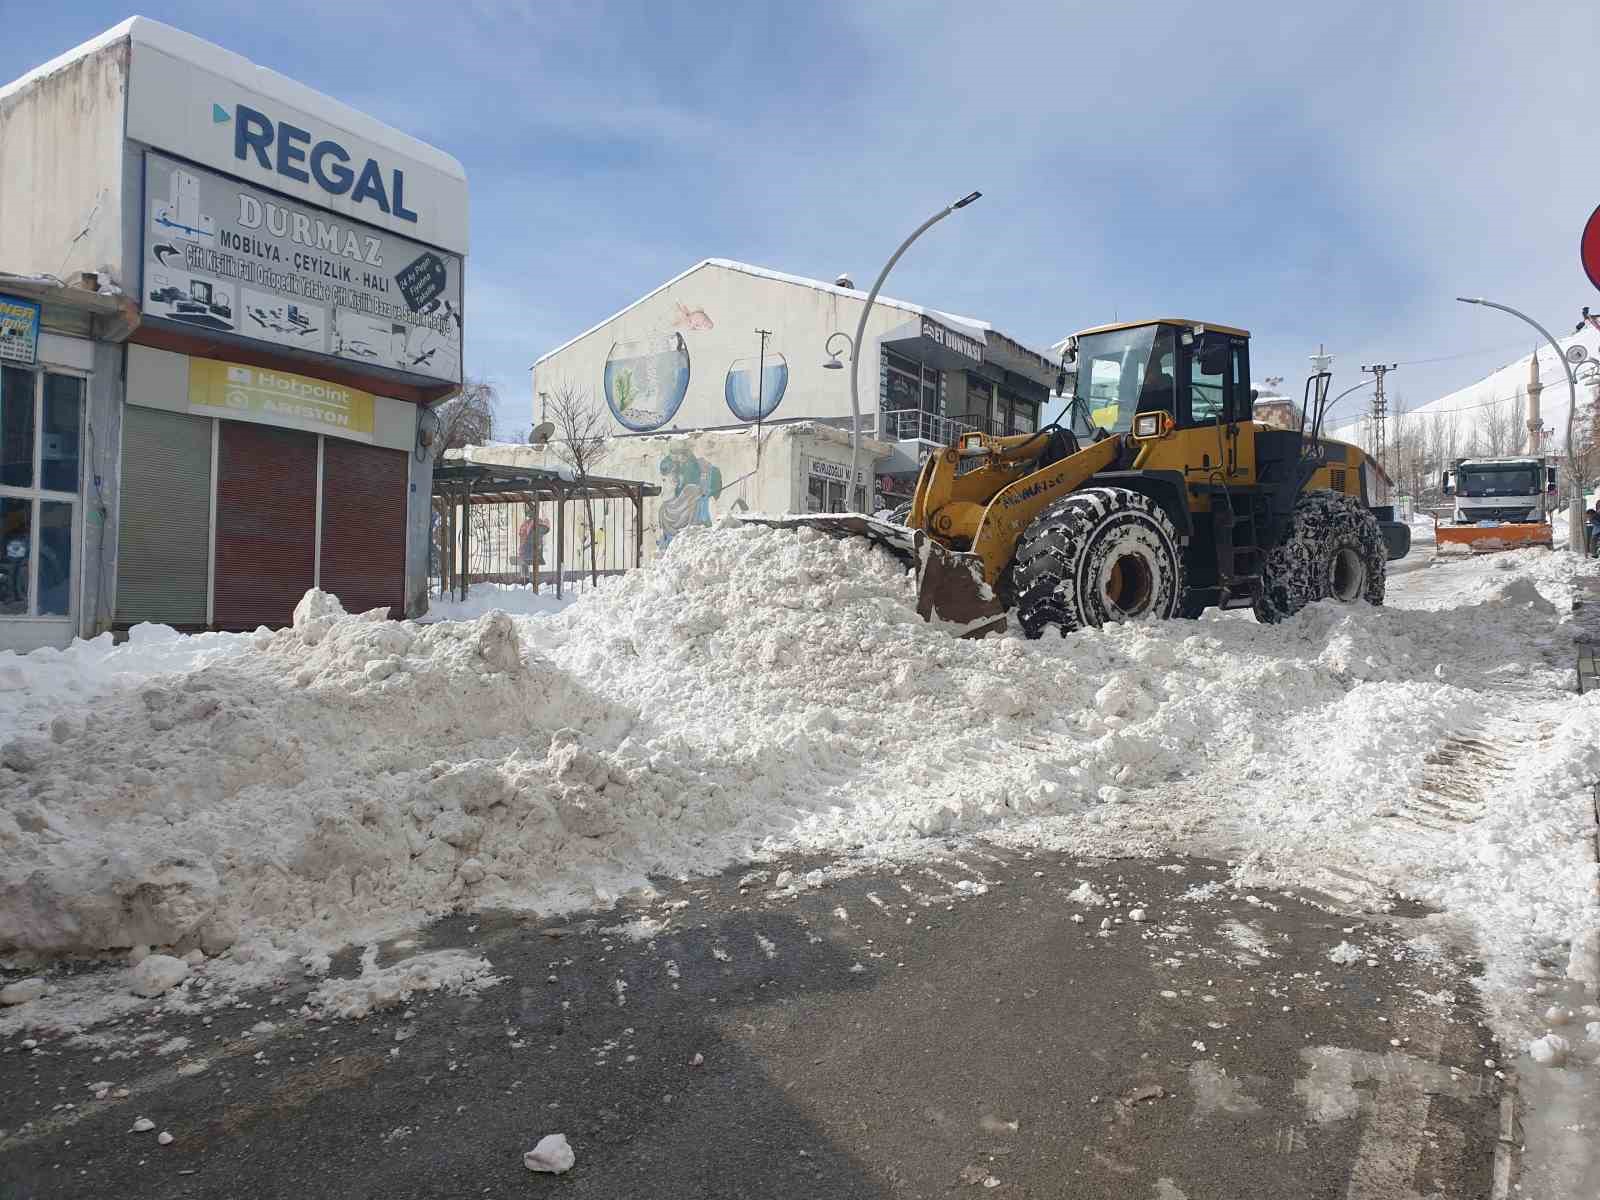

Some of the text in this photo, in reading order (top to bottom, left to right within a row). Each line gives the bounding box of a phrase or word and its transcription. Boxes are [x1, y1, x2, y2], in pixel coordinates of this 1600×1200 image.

[233, 104, 418, 223] REGAL
[237, 193, 384, 267] DURMAZ
[185, 244, 204, 272] Çift
[220, 230, 281, 263] MOBİLYA
[294, 252, 351, 283] ÇEYİZLİK
[363, 271, 389, 293] HALI
[258, 372, 350, 403] Hotpoint
[263, 399, 349, 425] ARISTON
